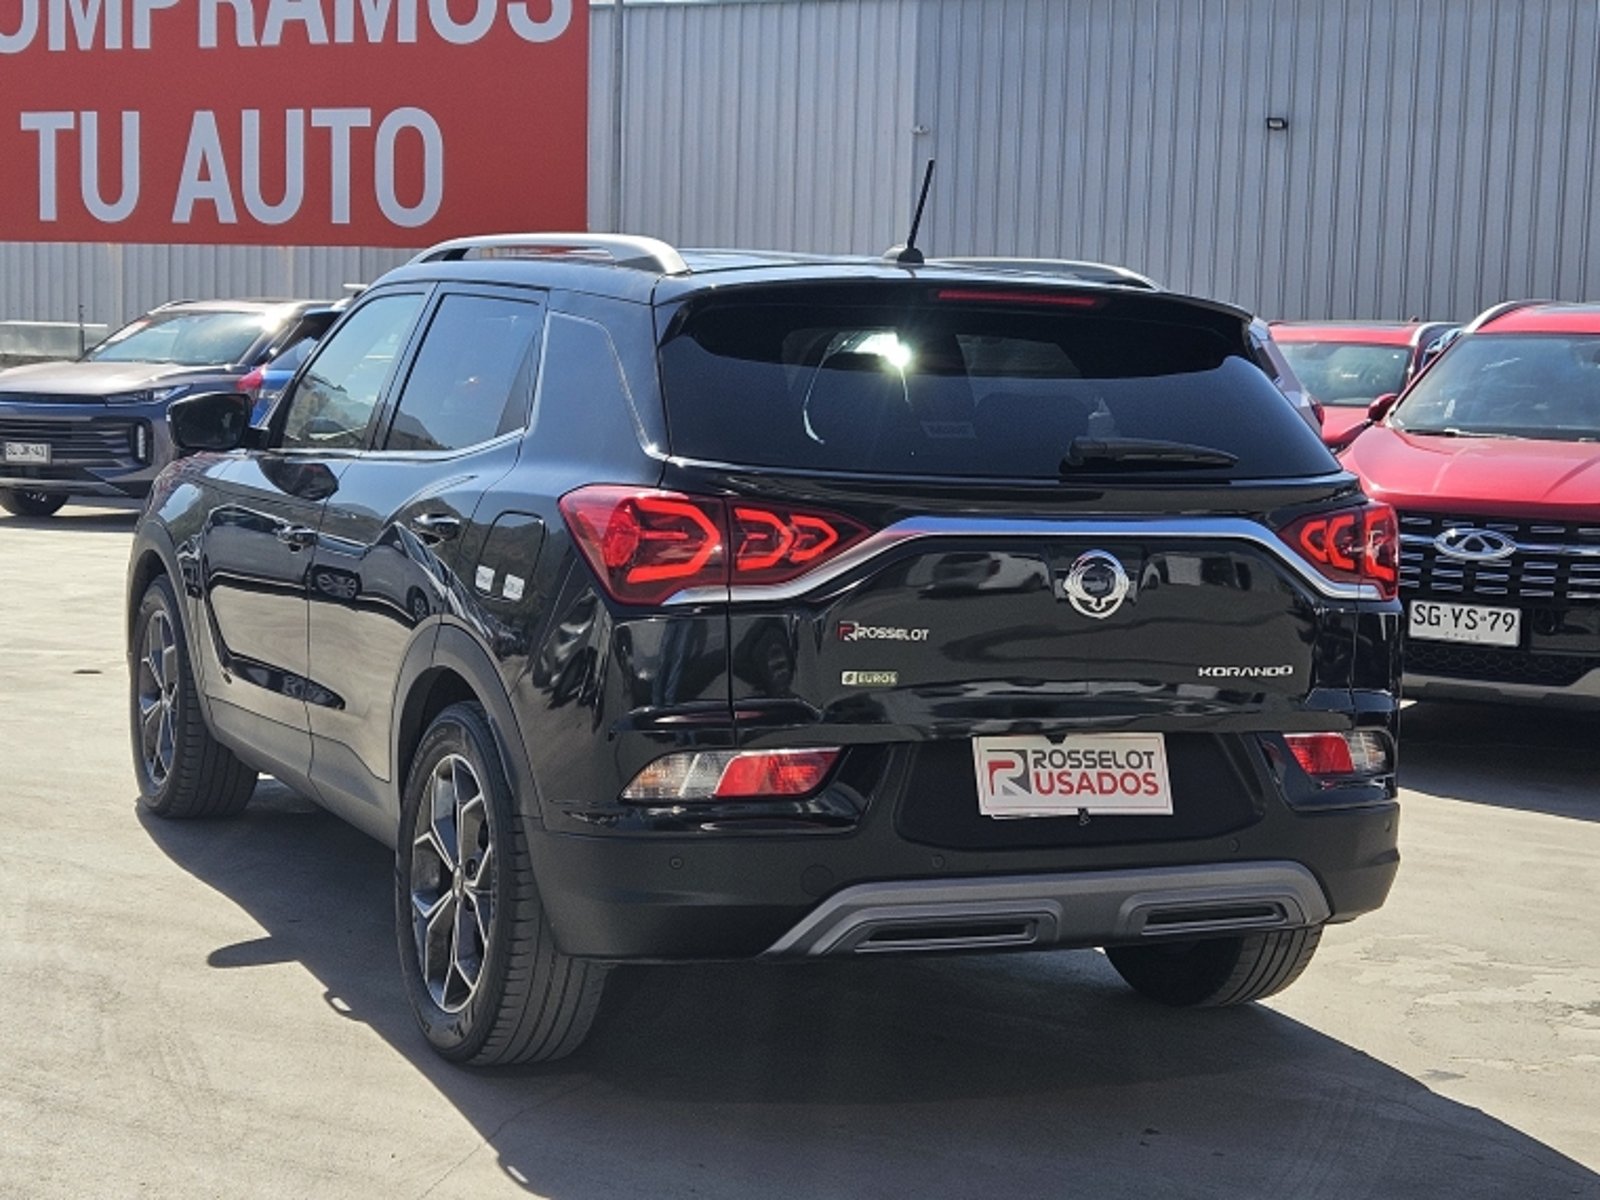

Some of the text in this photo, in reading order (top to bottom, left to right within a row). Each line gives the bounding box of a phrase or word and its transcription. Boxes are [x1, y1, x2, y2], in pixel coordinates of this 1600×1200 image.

[20, 106, 444, 227] TU AUTO
[857, 626, 929, 641] ROSSELOT
[1198, 665, 1293, 677] KORANDO
[1032, 750, 1155, 770] ROSSELOT
[1034, 772, 1160, 796] USADOS
